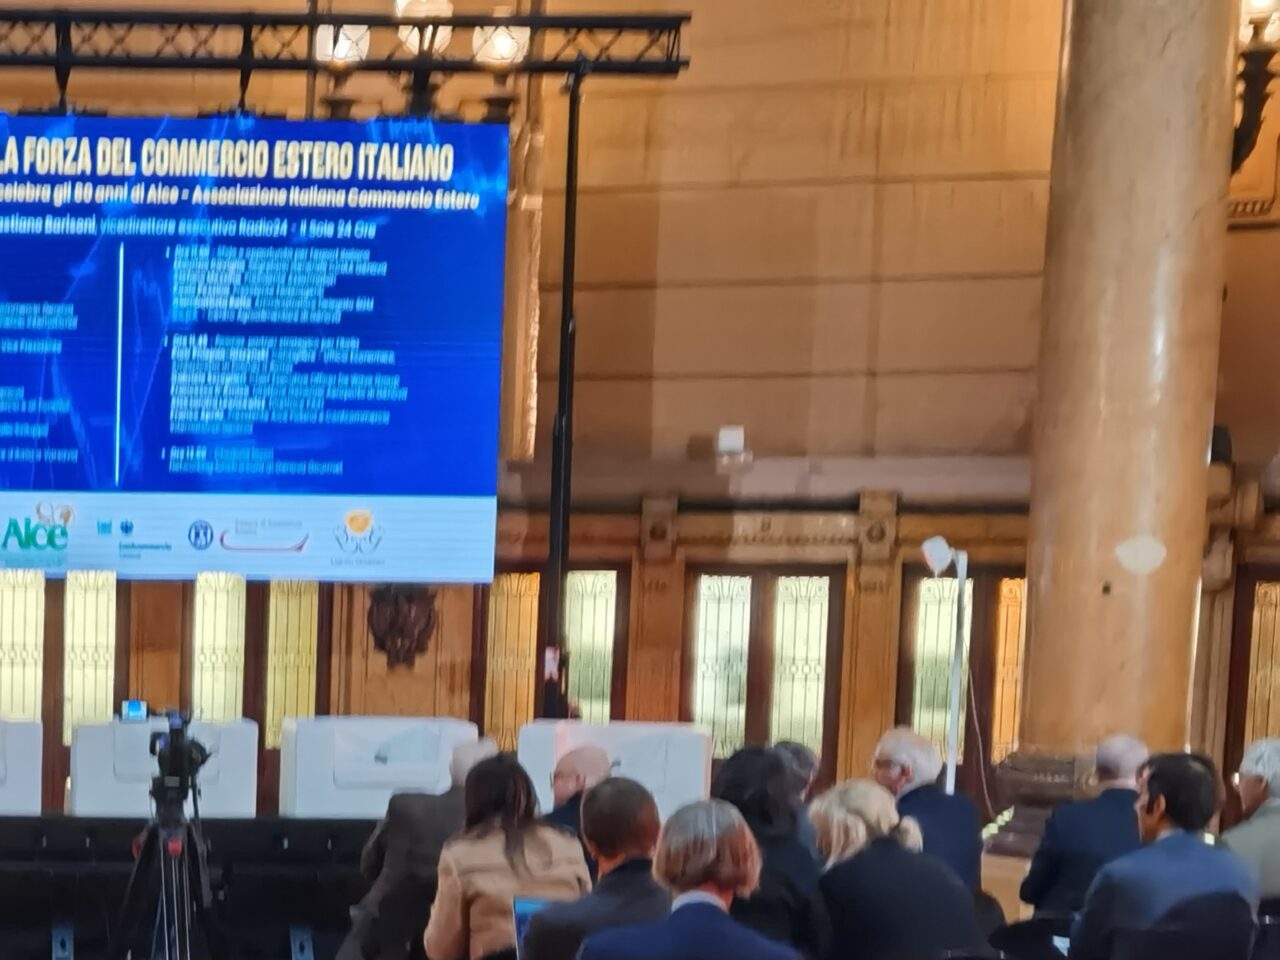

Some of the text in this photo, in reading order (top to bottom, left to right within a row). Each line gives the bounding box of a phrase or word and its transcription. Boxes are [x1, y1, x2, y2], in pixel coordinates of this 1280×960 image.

[23, 137, 92, 176] FORZA
[96, 138, 137, 177] DEL
[140, 138, 269, 178] COMMERCIO
[273, 140, 354, 180] ESTERO
[357, 142, 455, 182] ITALIANO
